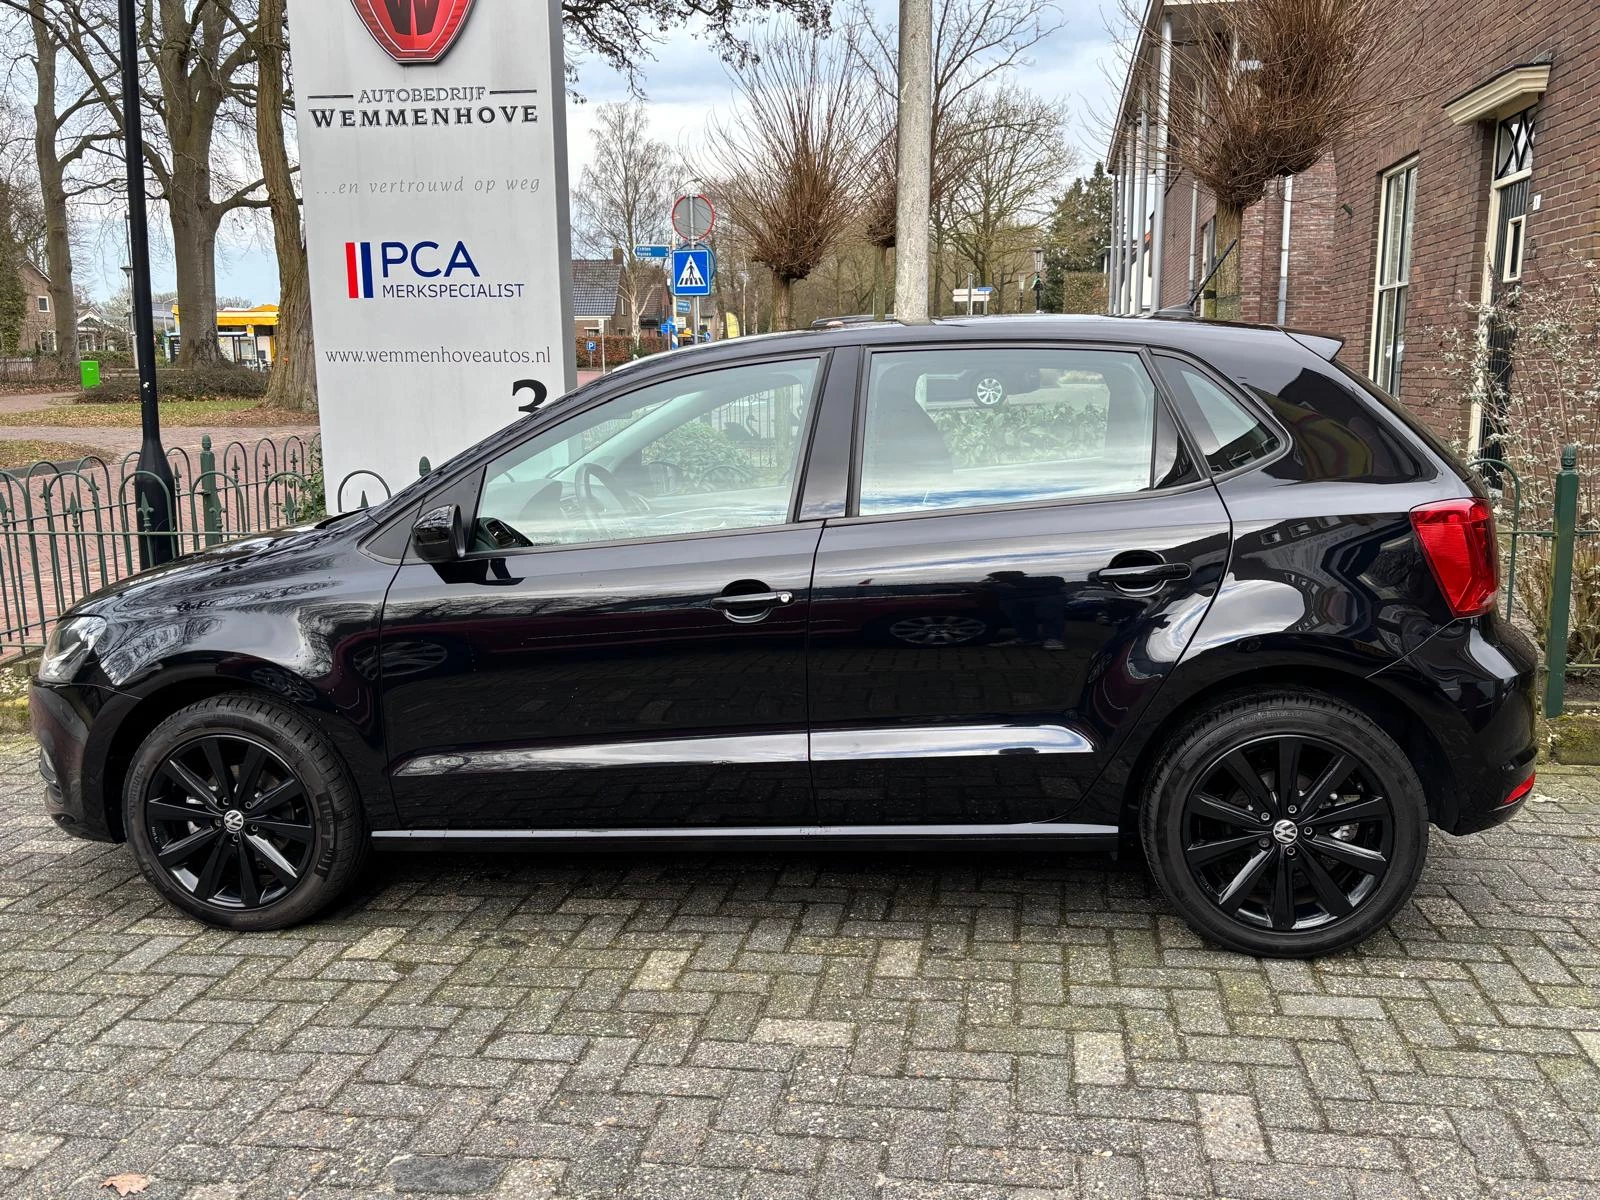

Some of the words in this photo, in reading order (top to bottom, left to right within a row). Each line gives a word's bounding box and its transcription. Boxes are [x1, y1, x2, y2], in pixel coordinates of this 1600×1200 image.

[358, 86, 486, 104] AUTOBEDRIJF
[308, 105, 538, 128] WEMMENHOVE
[369, 176, 464, 194] vertrouwd
[474, 180, 496, 195] op
[506, 177, 541, 194] weg
[381, 240, 480, 278] PCA
[382, 283, 525, 298] MERKSPECIALIST
[325, 346, 551, 364] www.wemmenhoveautos.nl
[512, 379, 547, 414] 3
